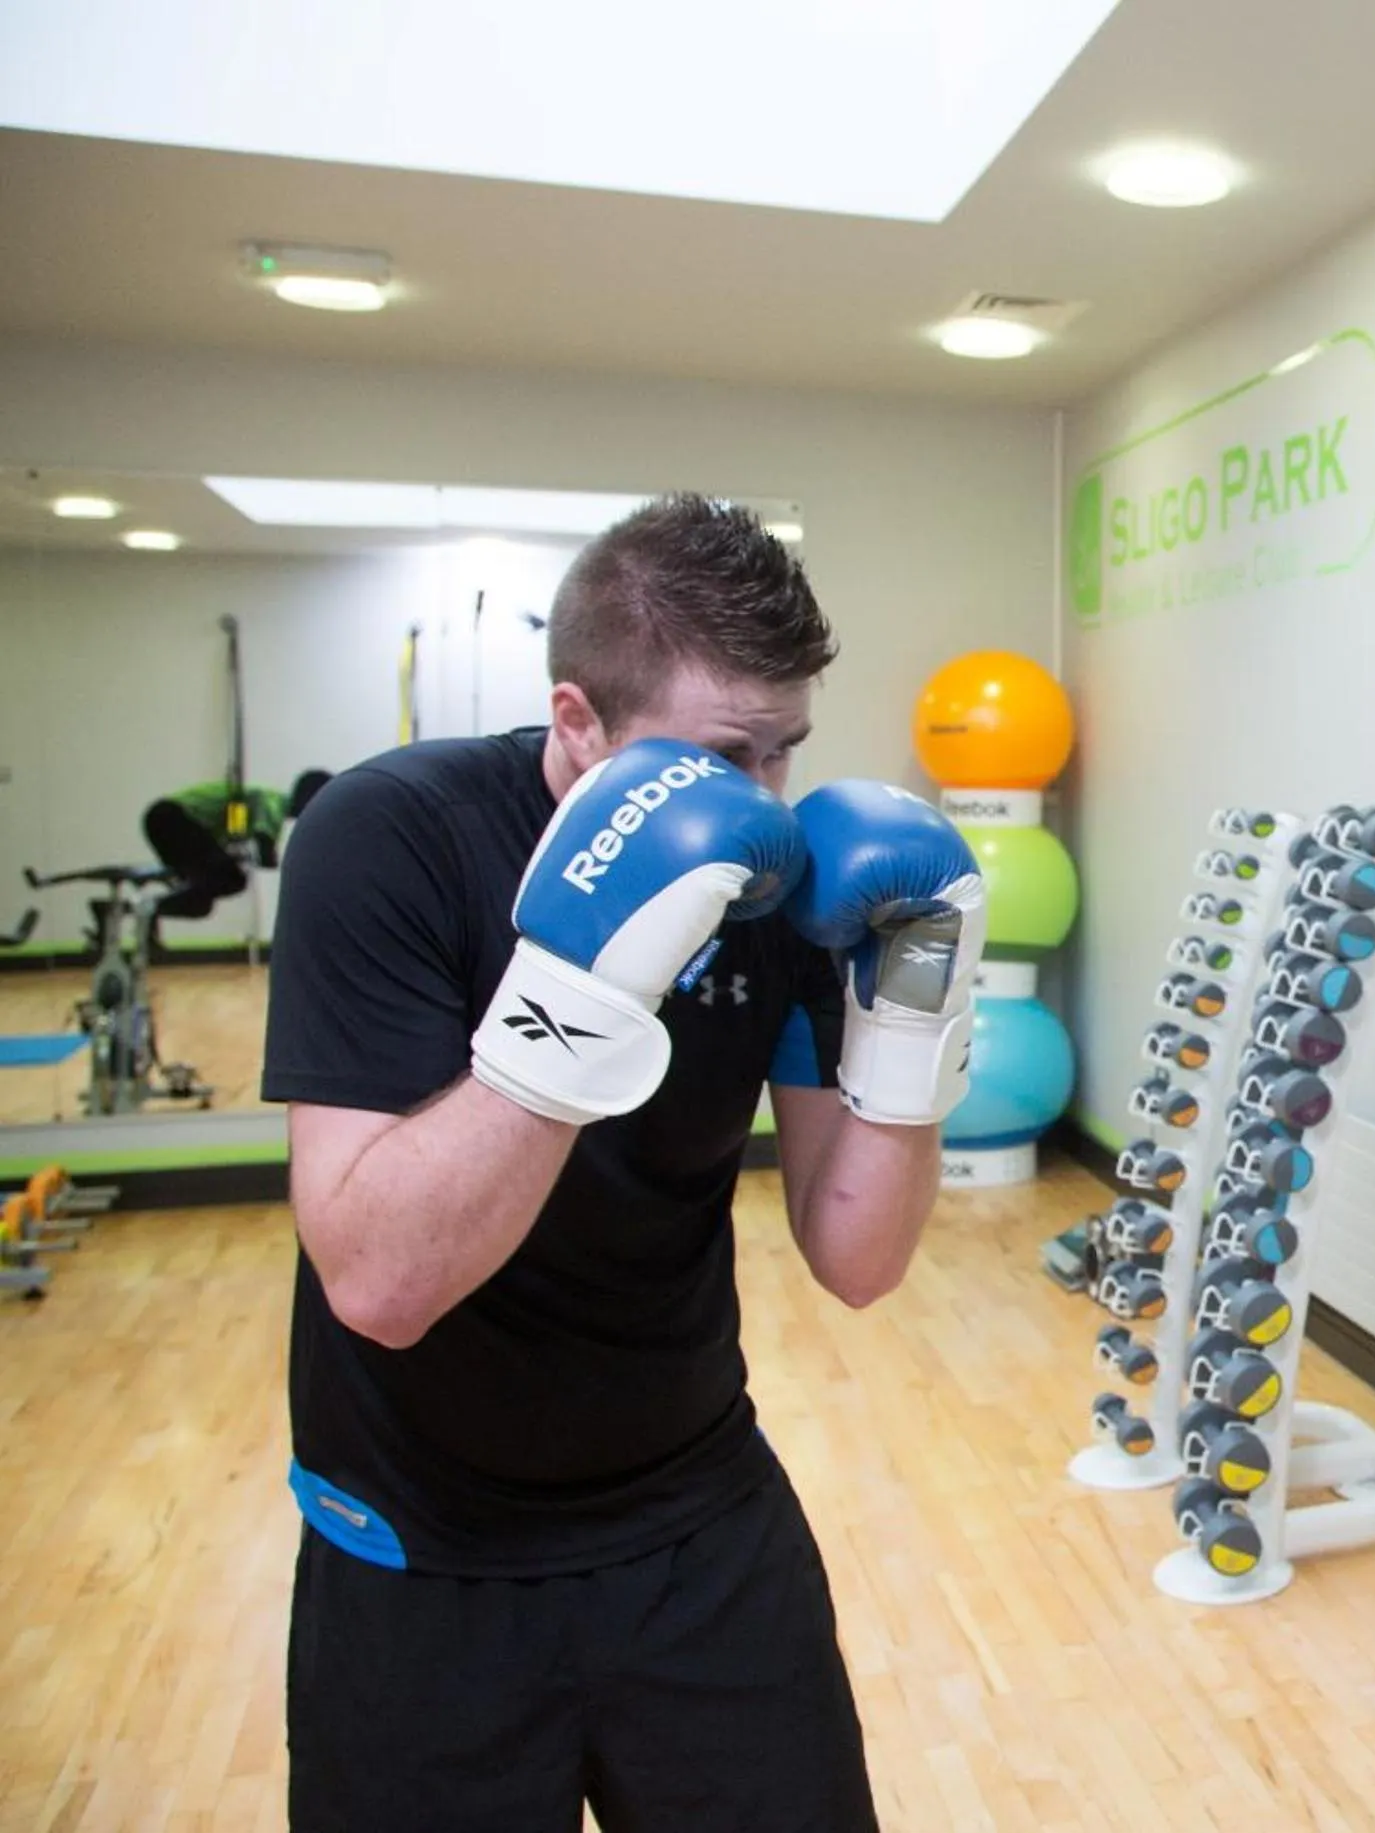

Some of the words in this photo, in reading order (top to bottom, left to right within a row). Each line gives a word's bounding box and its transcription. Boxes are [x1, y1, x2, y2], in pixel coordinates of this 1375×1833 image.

[1111, 475, 1209, 567] SLIGO
[1220, 414, 1349, 532] PARK
[562, 756, 727, 895] Reebok
